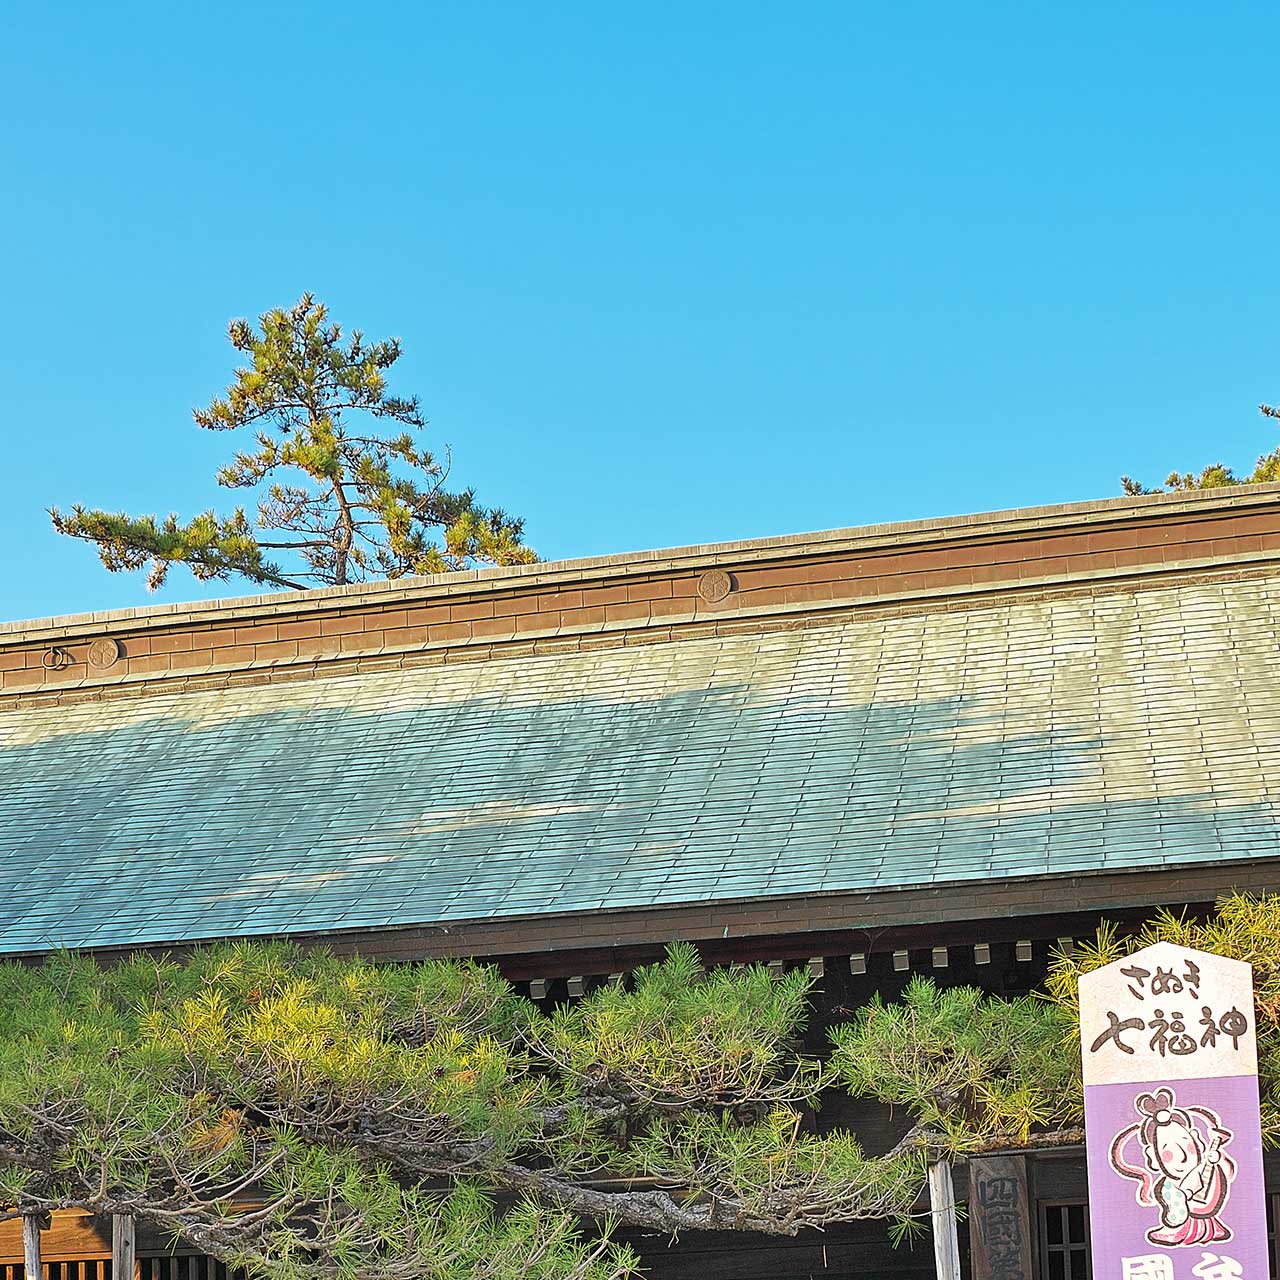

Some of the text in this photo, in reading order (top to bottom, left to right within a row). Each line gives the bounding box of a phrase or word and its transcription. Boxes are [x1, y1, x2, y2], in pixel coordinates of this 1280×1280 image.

[1120, 958, 1201, 1000] さぬき
[1090, 1005, 1248, 1057] 七福神
